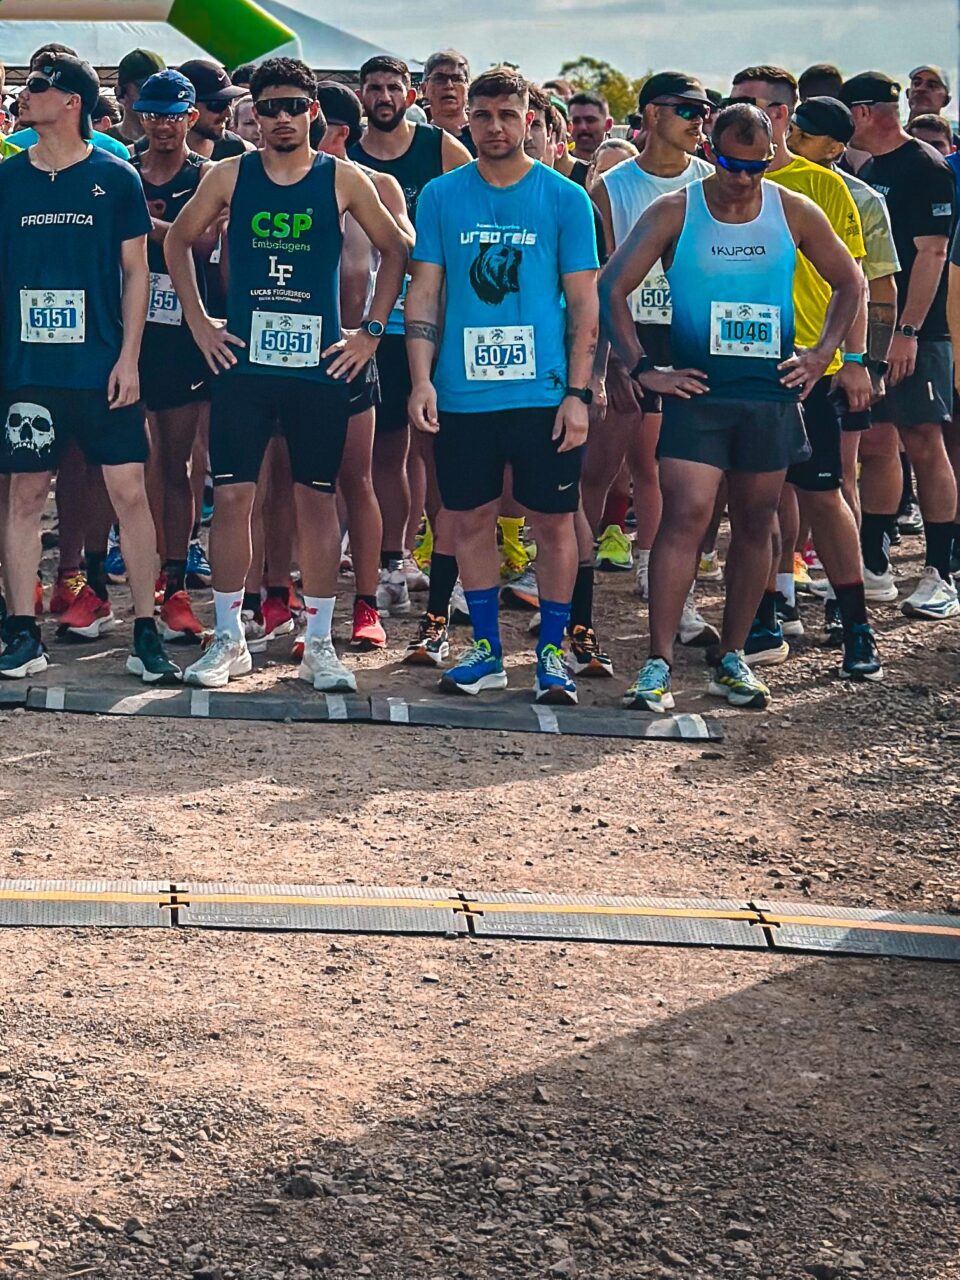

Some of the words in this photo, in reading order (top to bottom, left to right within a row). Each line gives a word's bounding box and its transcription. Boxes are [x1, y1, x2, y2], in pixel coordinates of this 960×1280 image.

[251, 211, 313, 239] CSP
[251, 238, 311, 253] Embalagens
[33, 308, 71, 327] 5151
[725, 320, 768, 341] 1046
[265, 331, 308, 353] 5051
[478, 345, 524, 365] 5075
